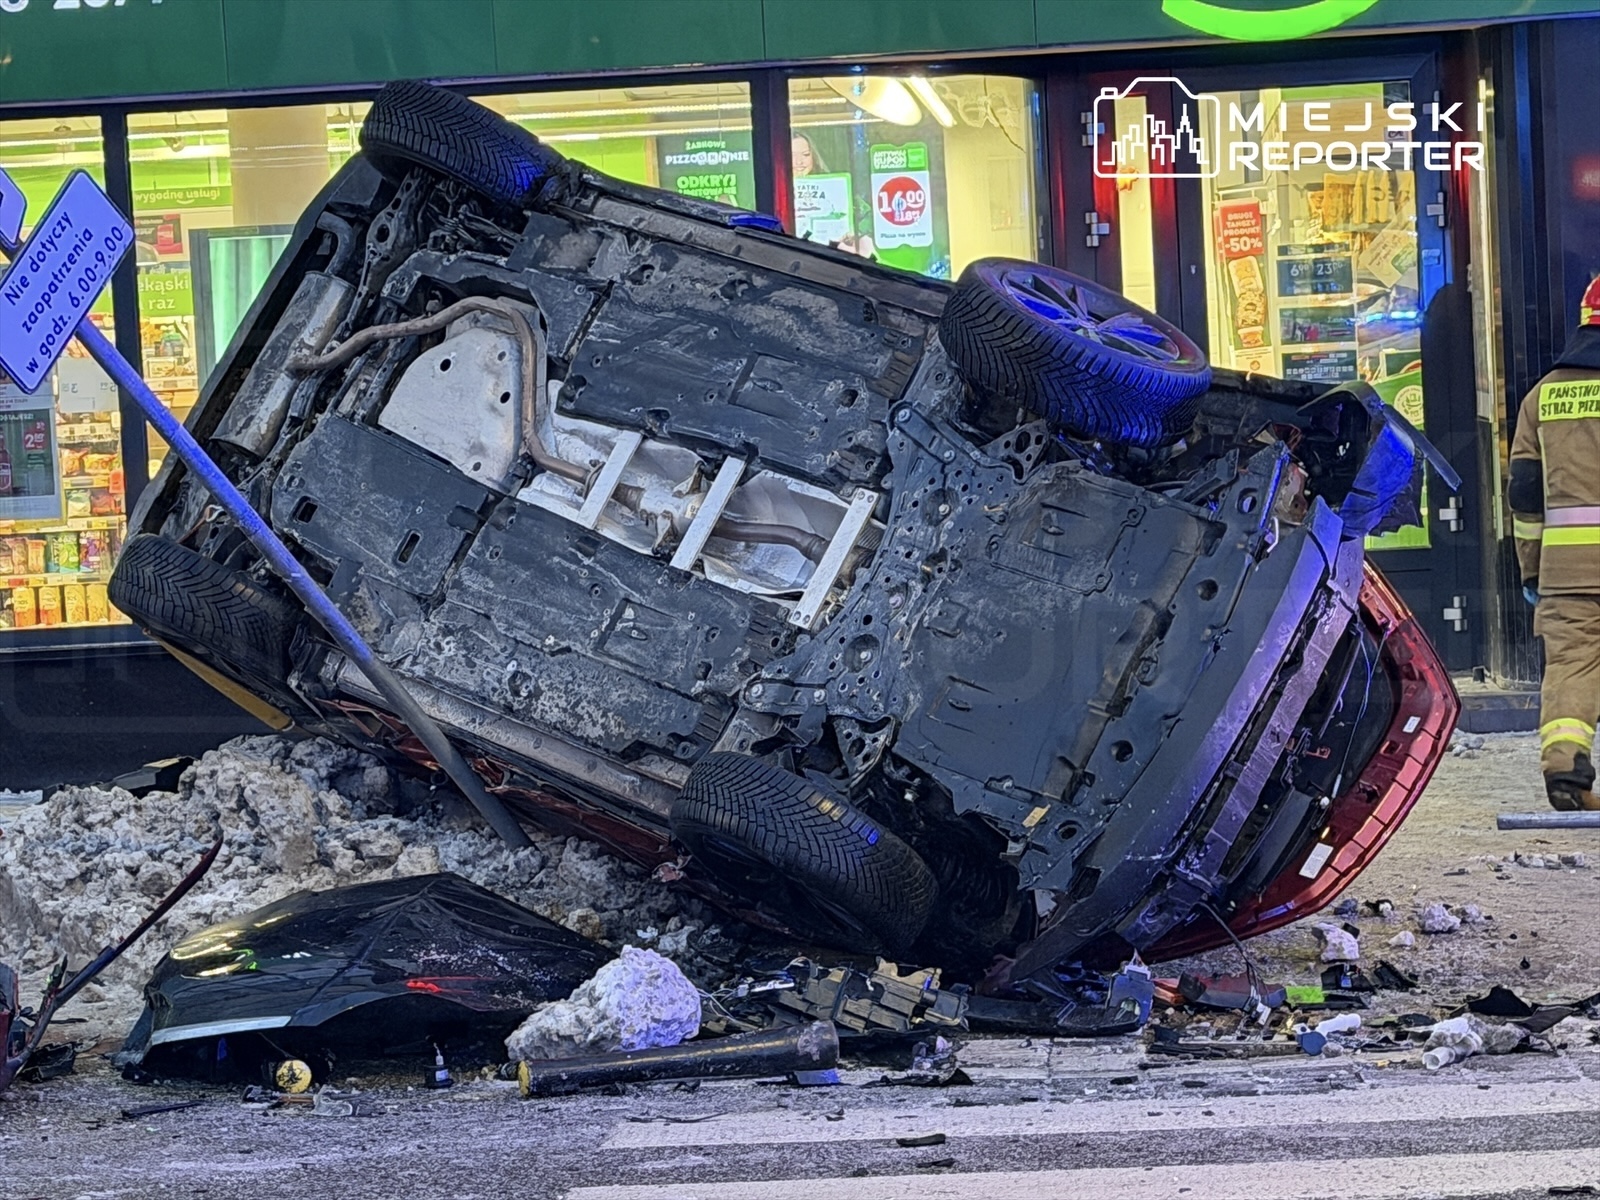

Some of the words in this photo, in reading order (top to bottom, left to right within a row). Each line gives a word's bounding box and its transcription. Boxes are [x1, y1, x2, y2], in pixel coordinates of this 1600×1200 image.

[677, 174, 736, 189] ODKRYJ
[4, 274, 30, 306] Nie
[29, 211, 74, 273] dotyczy
[1224, 236, 1263, 253] -50%
[21, 227, 94, 334] zaopatrzenia
[26, 357, 39, 374] w
[39, 314, 72, 359] godz.
[68, 226, 124, 309] 6.00-9.00
[148, 298, 176, 310] raz
